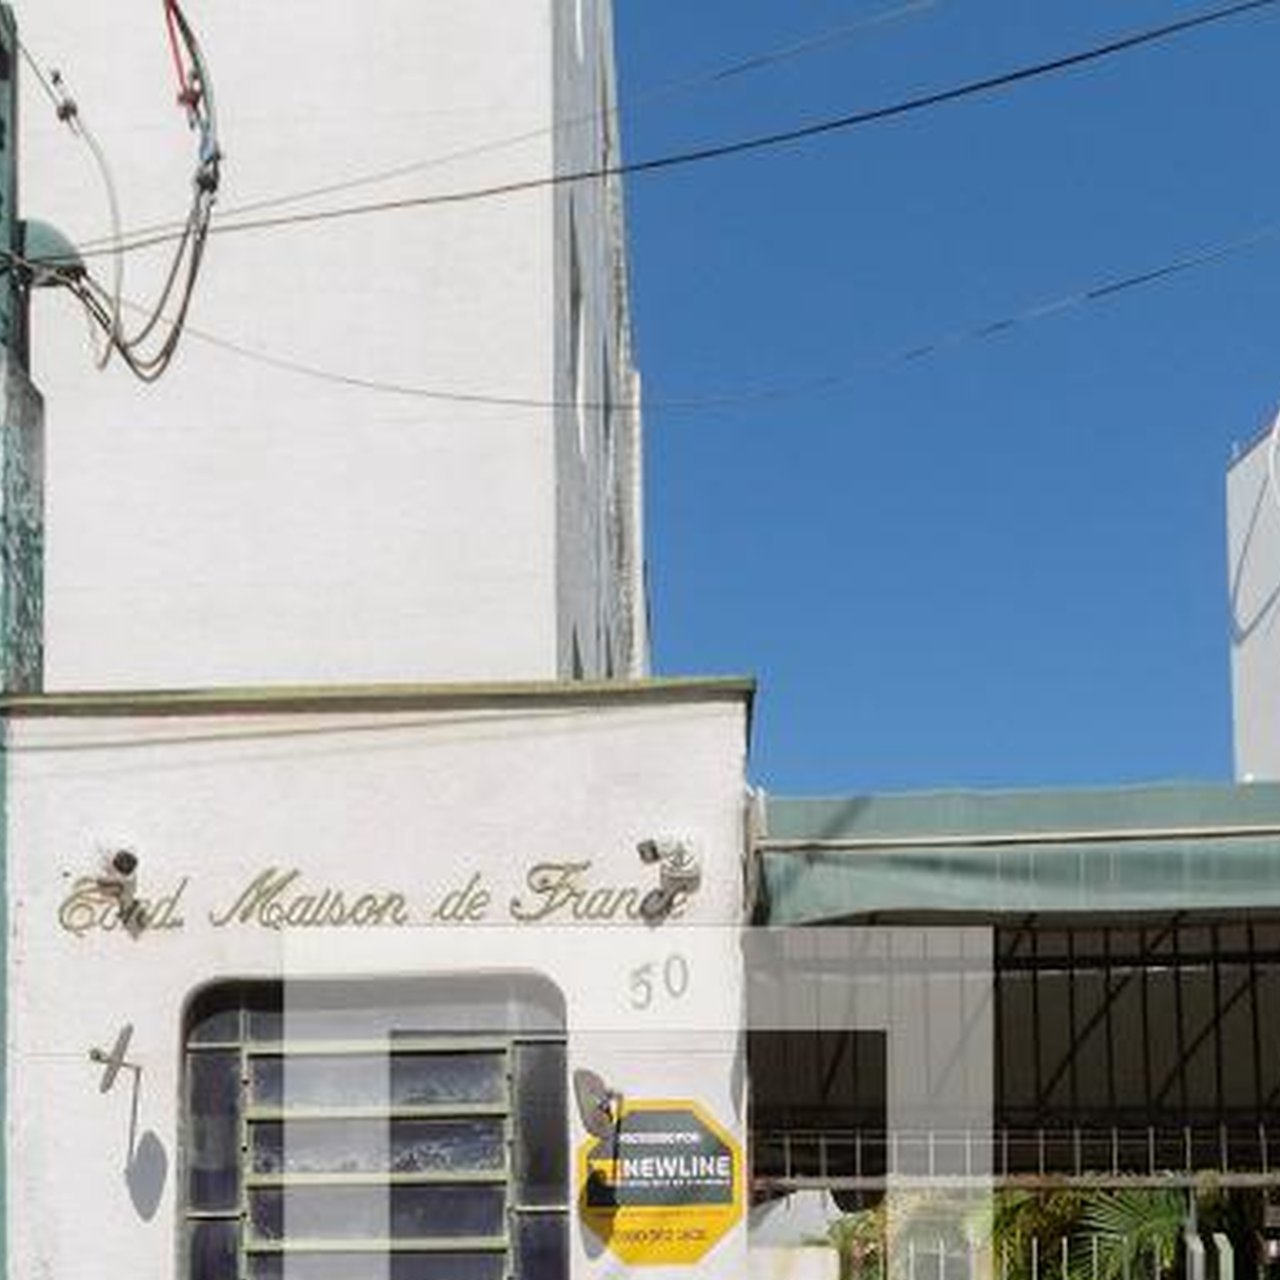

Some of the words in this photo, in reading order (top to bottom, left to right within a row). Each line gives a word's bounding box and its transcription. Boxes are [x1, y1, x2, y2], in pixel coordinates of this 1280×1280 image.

[209, 868, 409, 931] Maison
[431, 871, 492, 922] de
[629, 954, 690, 1010] 50
[621, 1155, 731, 1178] NEWLINE
